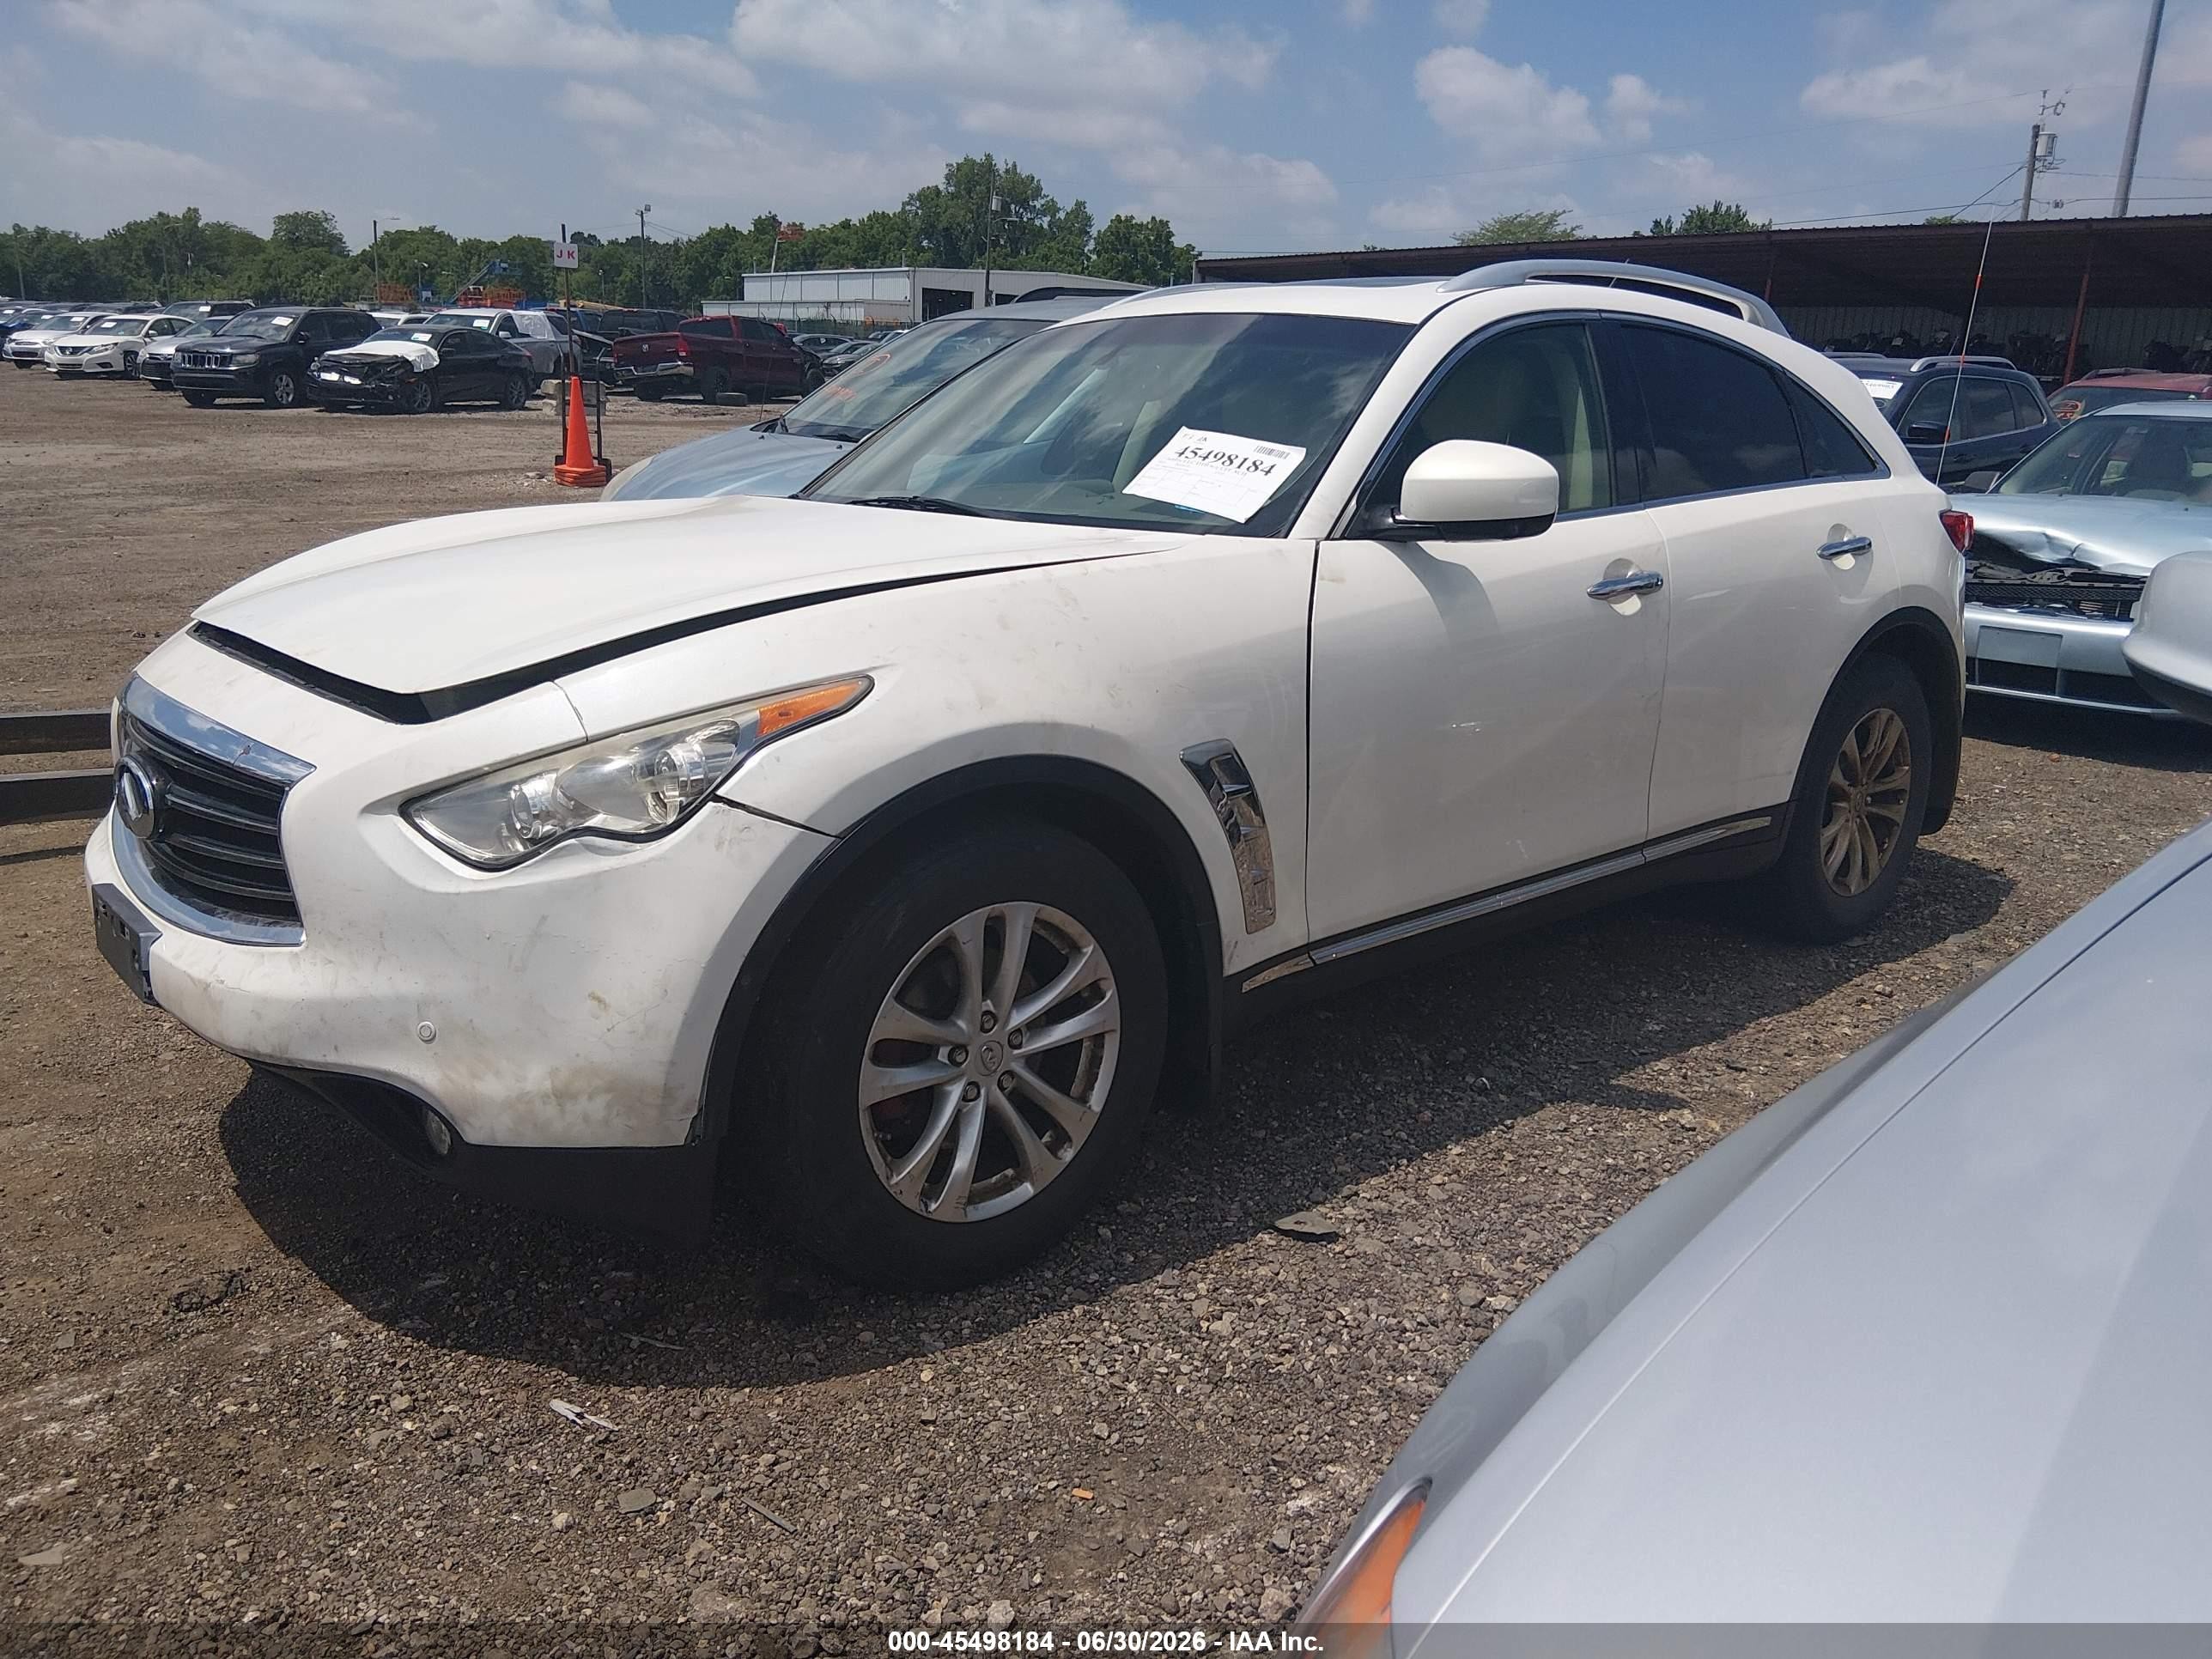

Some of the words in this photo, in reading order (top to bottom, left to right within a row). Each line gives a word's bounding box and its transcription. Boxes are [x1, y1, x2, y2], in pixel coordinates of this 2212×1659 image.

[556, 249, 563, 258] J
[567, 250, 575, 260] K
[1175, 445, 1277, 477] 45498184
